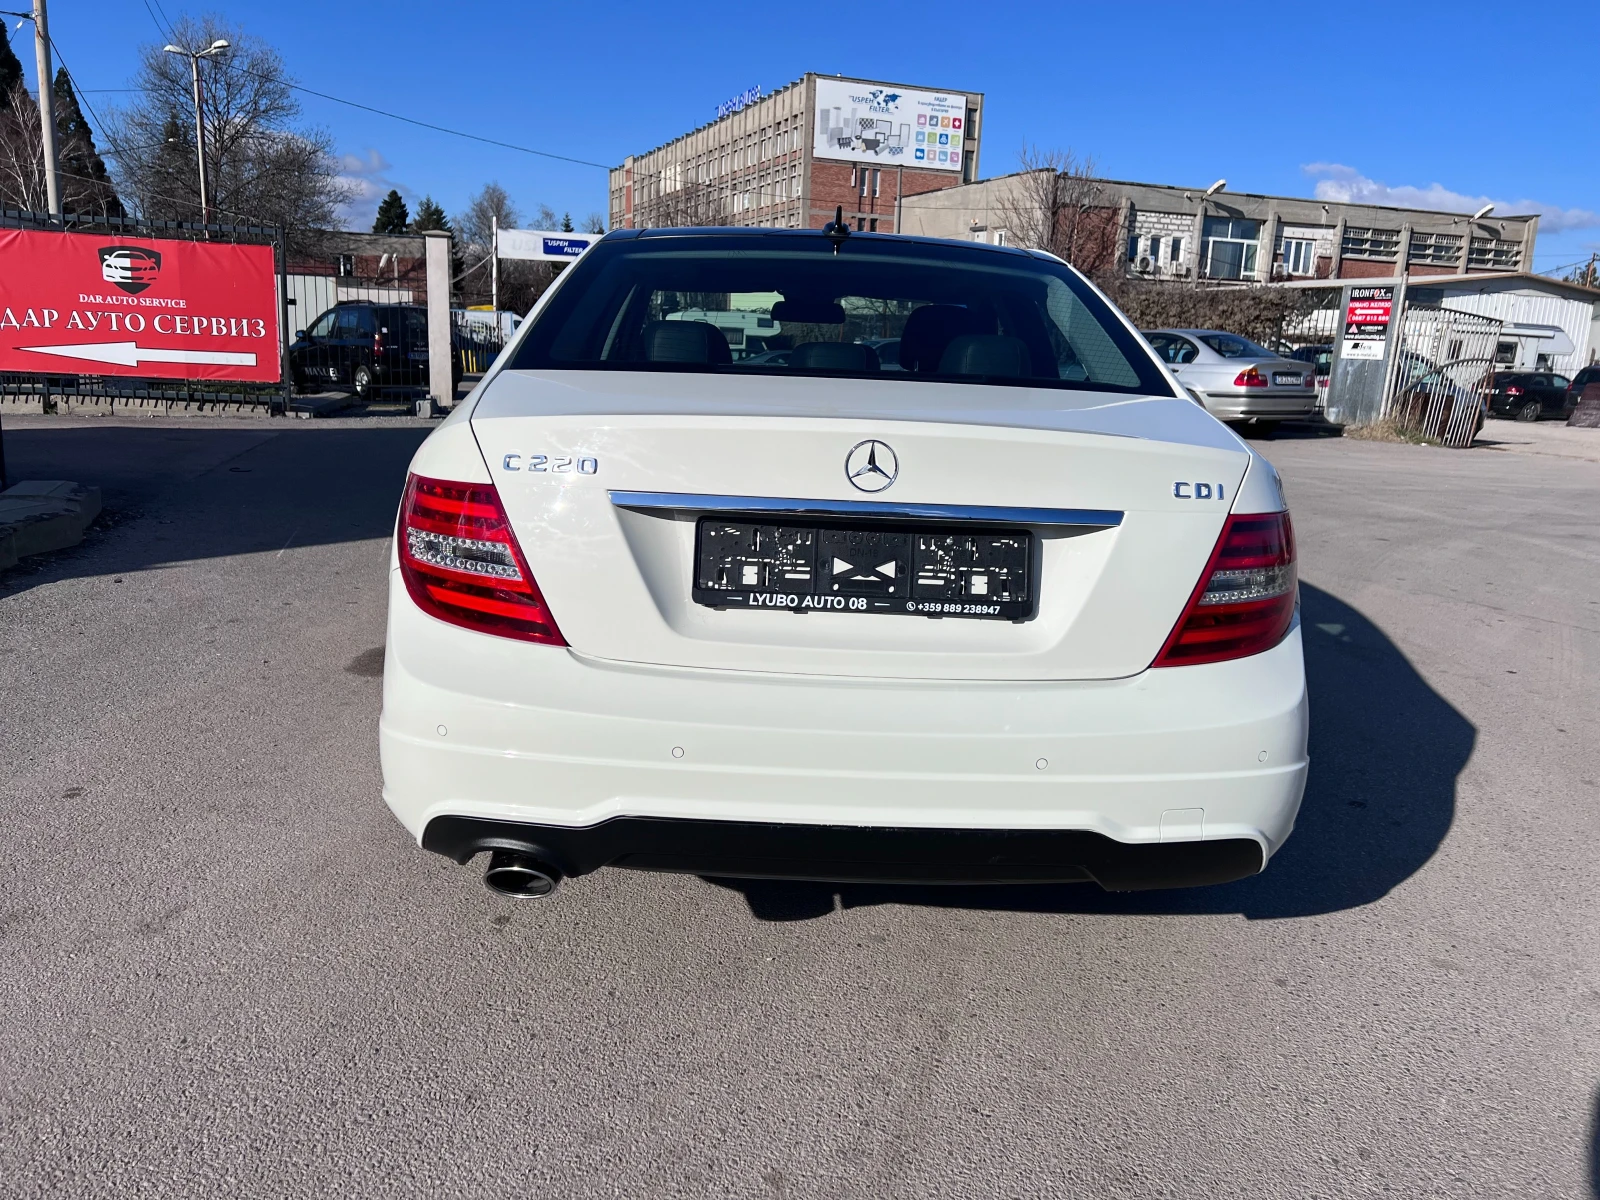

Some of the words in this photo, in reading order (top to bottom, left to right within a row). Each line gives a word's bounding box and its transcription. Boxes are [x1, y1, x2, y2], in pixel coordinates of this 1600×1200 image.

[850, 95, 874, 103] USPEH
[869, 105, 892, 113] FILTER
[79, 293, 104, 304] DAR
[104, 295, 138, 306] AUTO
[139, 297, 187, 308] SERVICE
[0, 307, 59, 331] ДАР
[66, 311, 146, 332] АУТО
[153, 314, 267, 338] СЕРВИЗ
[503, 453, 521, 471] C
[528, 454, 598, 475] 220
[1173, 481, 1225, 500] CDI
[749, 593, 798, 607] LYUBO
[802, 595, 845, 609] AUTO
[848, 597, 867, 610] 08
[917, 602, 942, 612] +359
[943, 604, 962, 613] 889
[963, 604, 1001, 615] 238947
